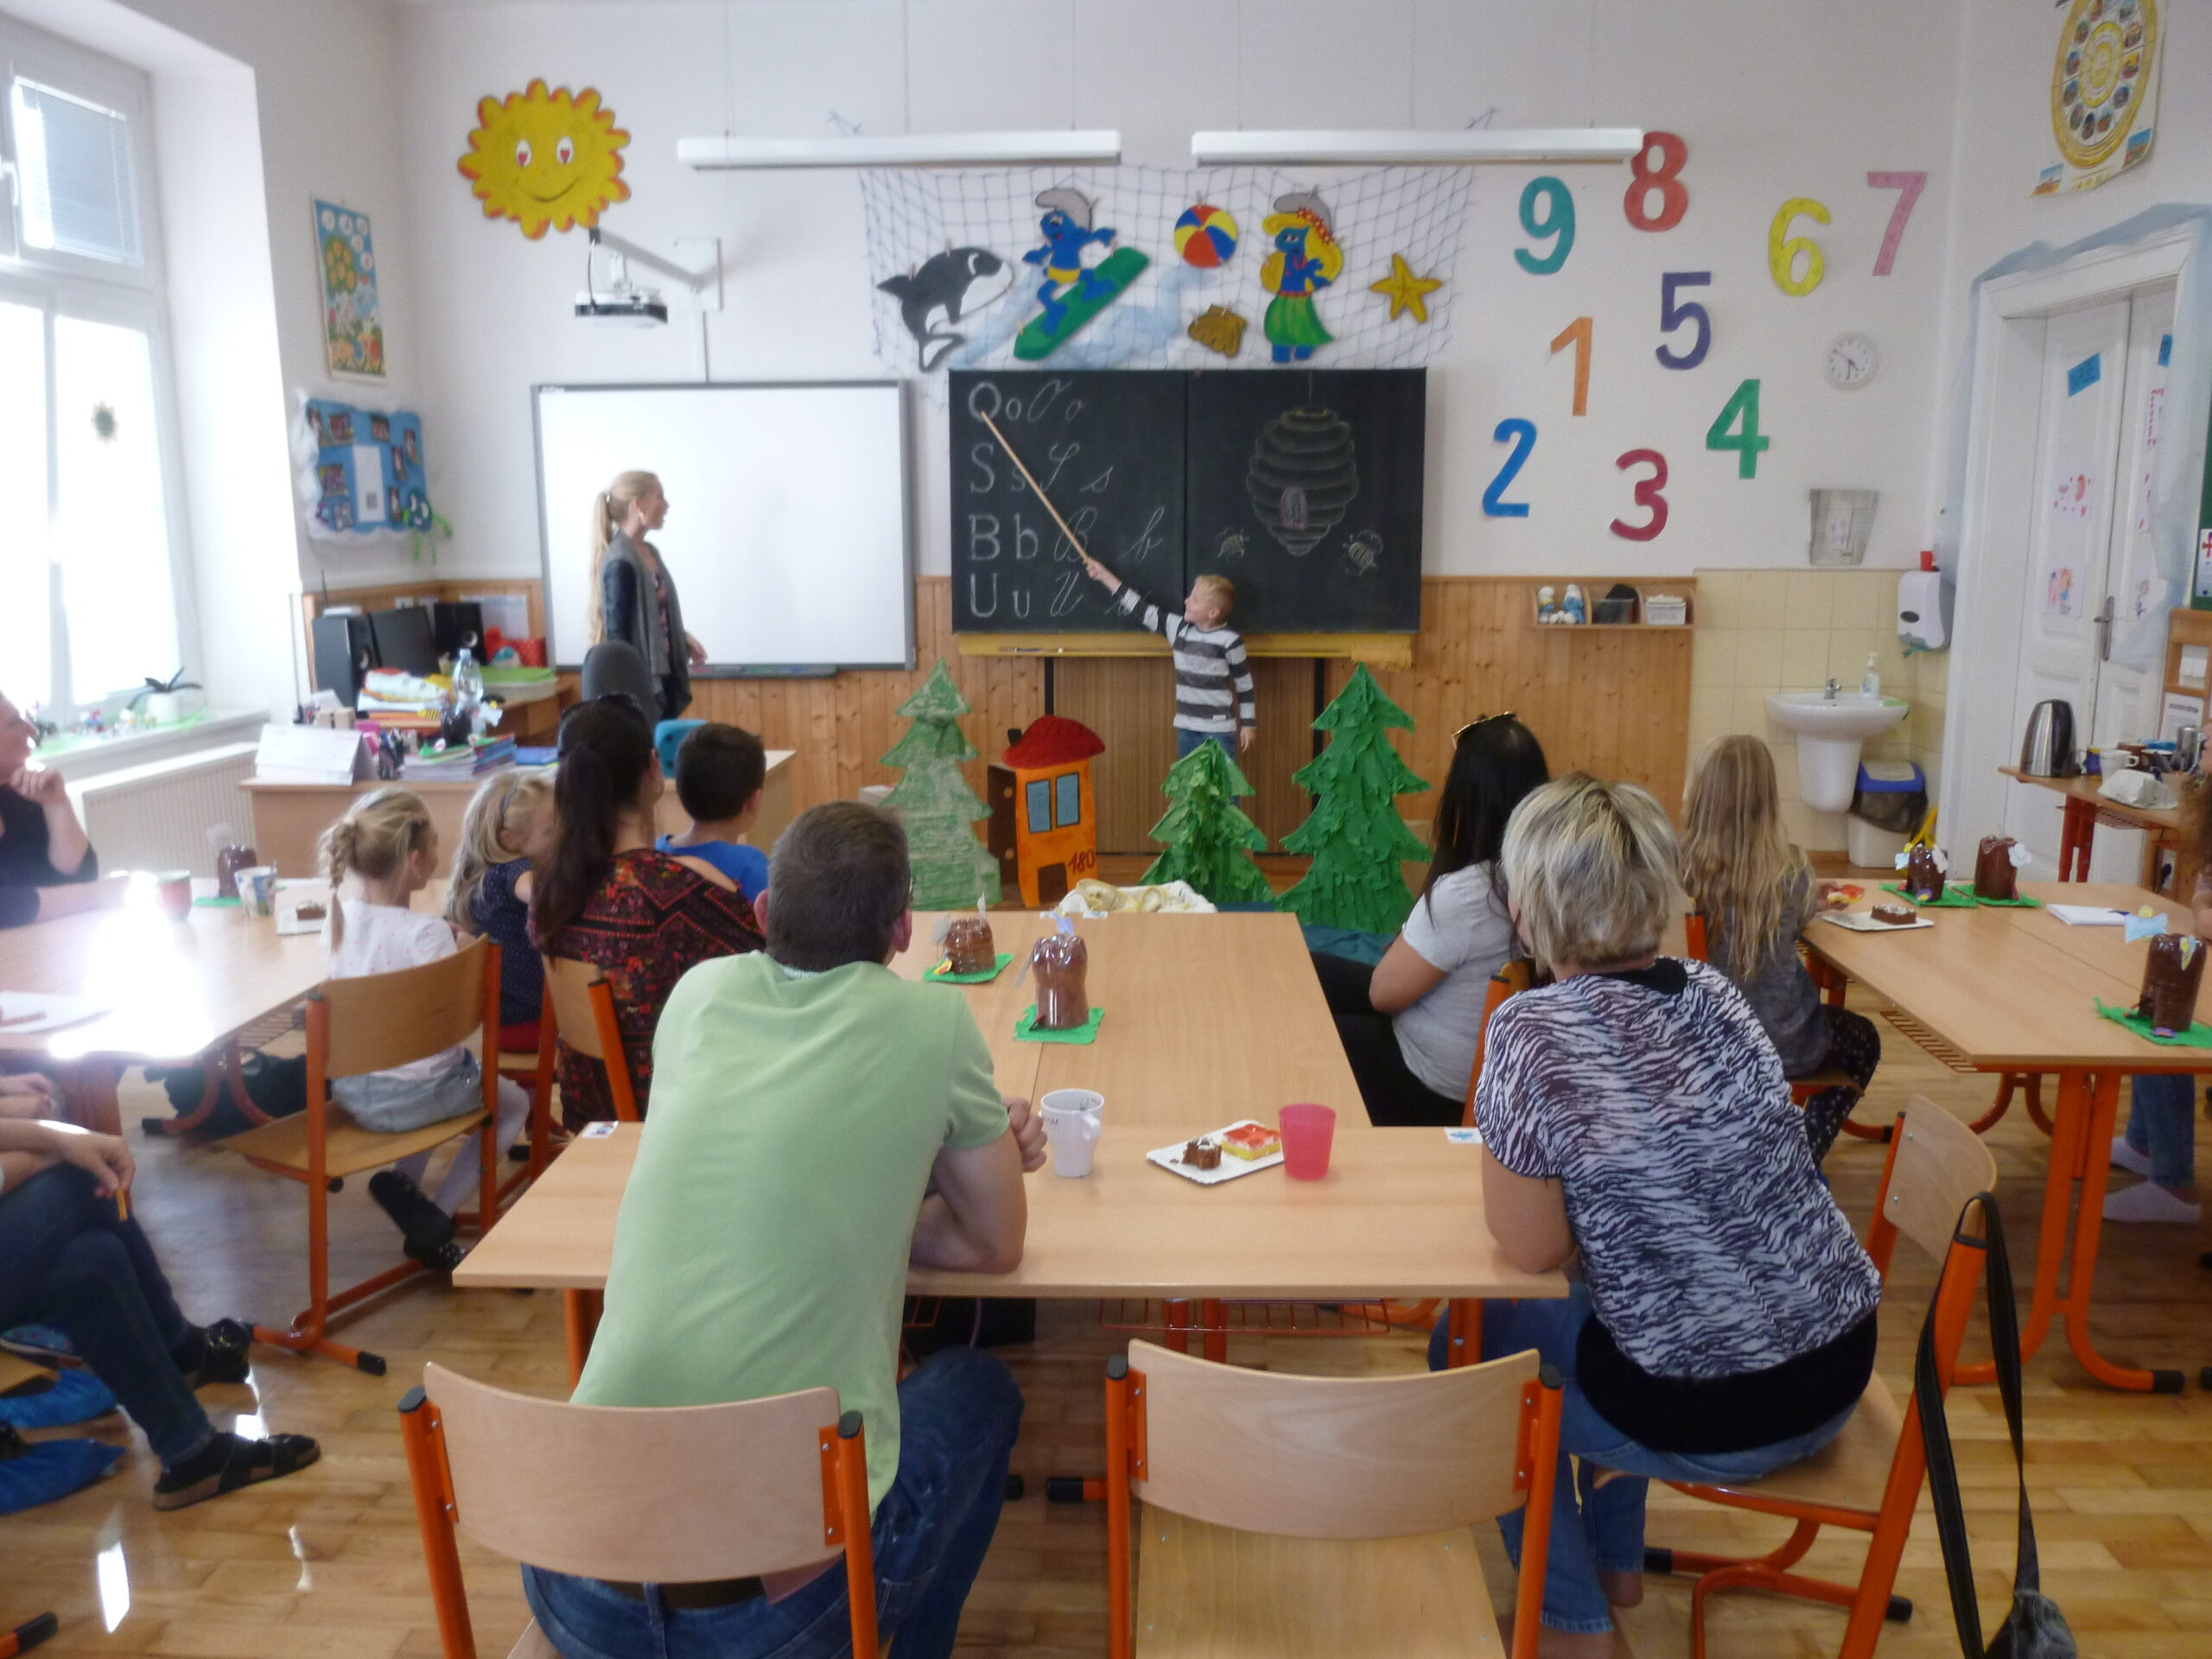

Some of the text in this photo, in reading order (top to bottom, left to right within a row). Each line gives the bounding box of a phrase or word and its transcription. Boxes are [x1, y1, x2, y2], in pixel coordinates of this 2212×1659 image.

[1514, 175, 1576, 276] 9
[1624, 131, 1689, 232] 8
[1866, 170, 1928, 276] 7
[1768, 197, 1832, 297] 6
[1550, 316, 1593, 416] 1
[1655, 270, 1712, 371] 5
[969, 442, 995, 493] S
[1482, 417, 1537, 518] 2
[1706, 378, 1770, 480] 4
[967, 513, 1001, 561] B
[1013, 512, 1039, 561] b
[1609, 448, 1669, 542] 3
[969, 572, 1000, 618] U
[1067, 849, 1096, 874] 180
